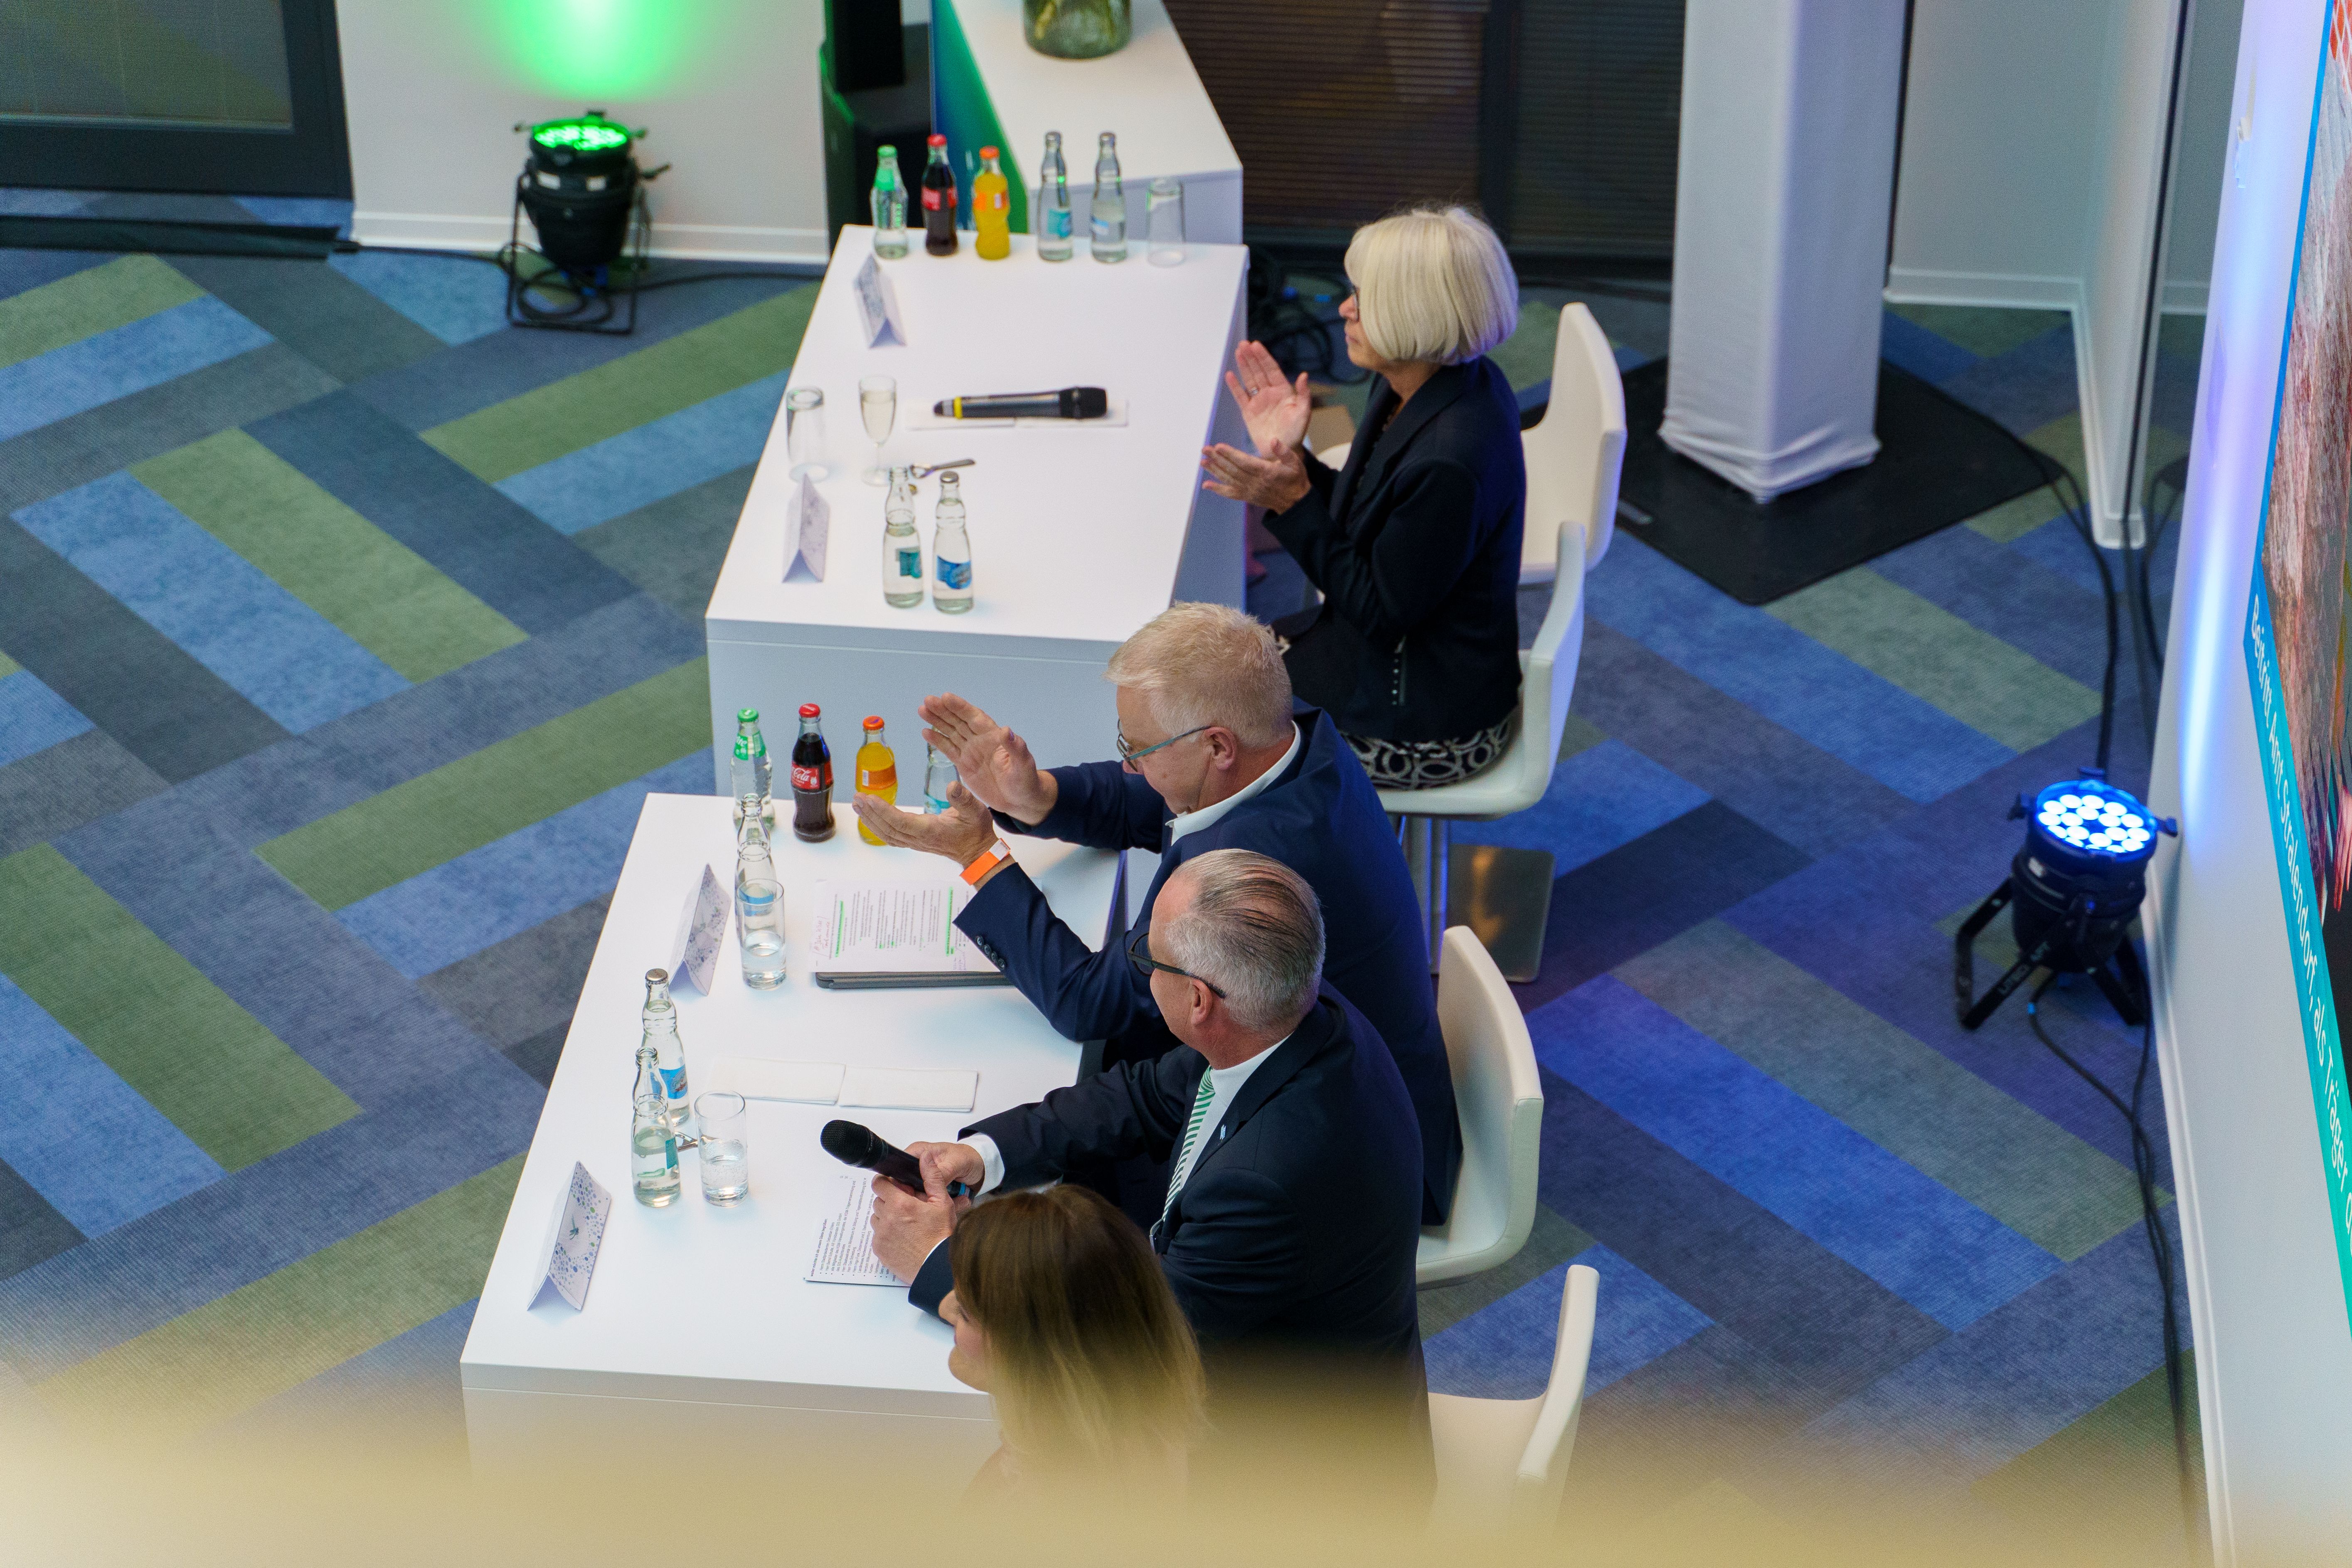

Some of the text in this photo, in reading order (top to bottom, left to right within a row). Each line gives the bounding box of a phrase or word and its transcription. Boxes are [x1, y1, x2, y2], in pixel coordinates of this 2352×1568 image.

[2269, 711, 2283, 800] Amt
[2281, 779, 2318, 1012] Stralendorf,
[2314, 997, 2326, 1067] als
[2324, 1046, 2347, 1193] Träger
